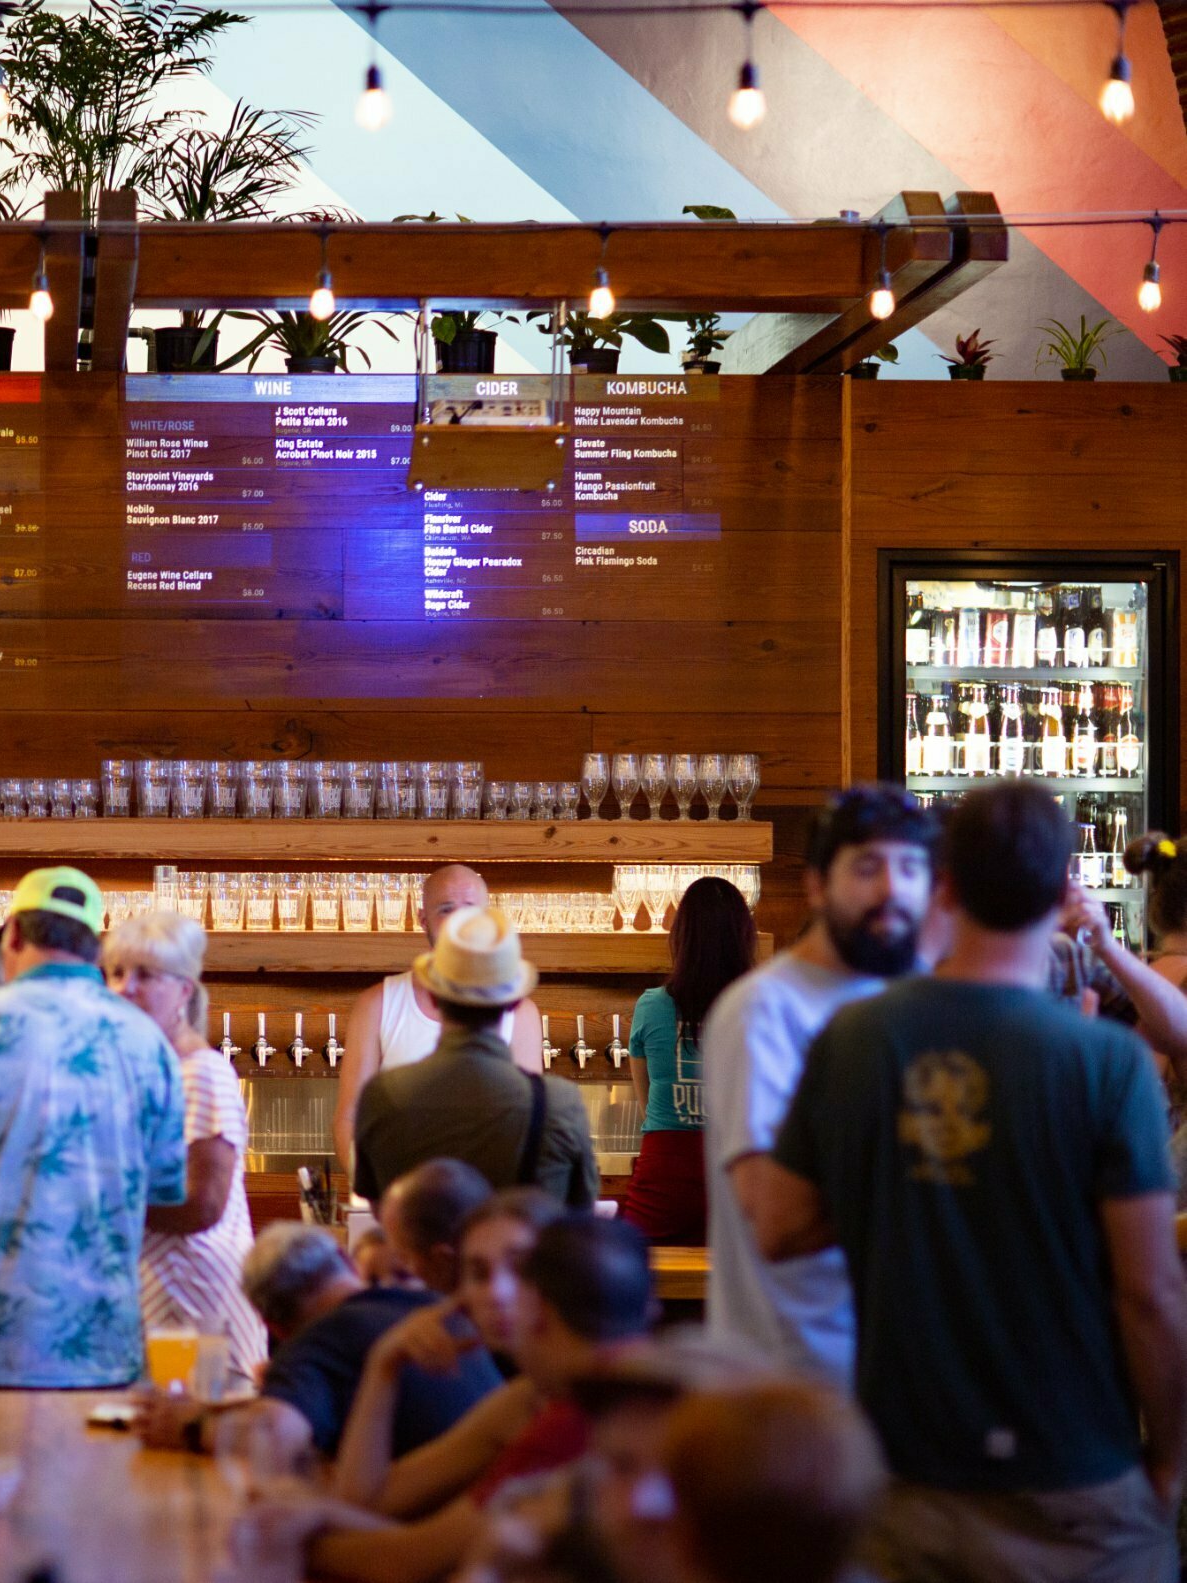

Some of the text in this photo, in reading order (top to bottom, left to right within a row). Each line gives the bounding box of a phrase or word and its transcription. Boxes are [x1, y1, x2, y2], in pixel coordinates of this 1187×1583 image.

[255, 381, 291, 395] WINE
[476, 382, 518, 395] CIDER
[607, 382, 687, 395] KOMBUCHA
[275, 407, 337, 416] J Scott Cellars
[575, 407, 641, 416] Happy Mountain
[276, 417, 347, 426] Petite Sirah 2016
[575, 417, 683, 425] White Lavender Kombucha
[131, 421, 194, 431] WHITE/ROSE
[16, 436, 38, 444] $5.50
[126, 439, 208, 447] William Rose Wines
[276, 439, 323, 450] King Estate
[575, 439, 605, 447] Elevate
[126, 449, 191, 458] Pinot Gris 2017
[276, 450, 377, 459] Acrobat Pinot Noir 2015
[575, 450, 677, 459] Summer Fling Kombucha
[127, 472, 213, 482] Storypoint Vineyards
[575, 472, 601, 480] Humm
[127, 482, 198, 492] Chardonnay 2016
[575, 482, 656, 493] Mango Passionfruit
[424, 492, 447, 501] Cider
[575, 492, 618, 500] Kombucha
[127, 505, 154, 513] Nobilo
[127, 515, 219, 526] Sauvignon Blanc 2017
[471, 525, 493, 534] Cider
[629, 520, 668, 533] SODA
[576, 546, 614, 555] Circadian
[132, 553, 150, 562] RED
[576, 557, 657, 566] Pink Flamingo Soda
[453, 558, 481, 568] Ginger
[127, 571, 212, 581] Eugene Wine Cellars
[127, 581, 201, 590] Recess Red Blend
[448, 600, 470, 609] Cider
